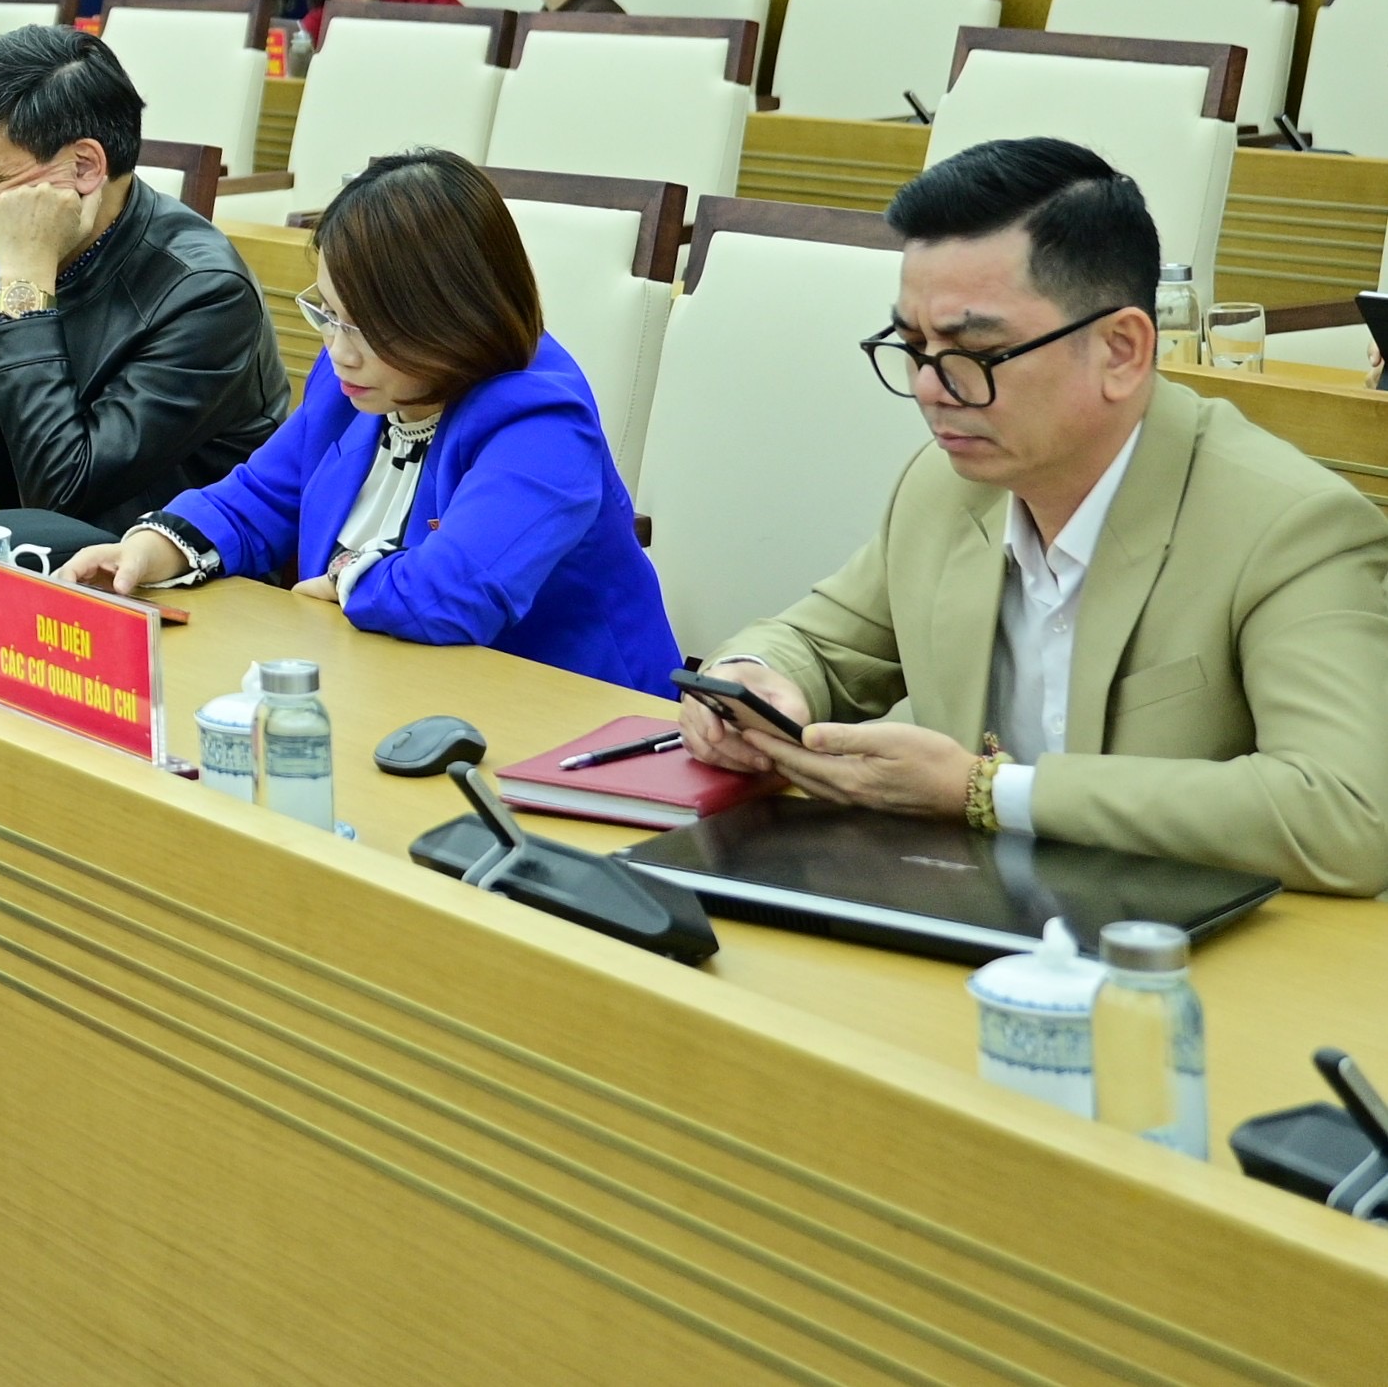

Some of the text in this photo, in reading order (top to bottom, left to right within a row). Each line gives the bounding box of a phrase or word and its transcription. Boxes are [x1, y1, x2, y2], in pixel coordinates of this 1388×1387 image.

[36, 614, 91, 662] ĐẠI DIỆN
[0, 644, 138, 723] CÁC CƠ QUAN BÁO CHÍ
